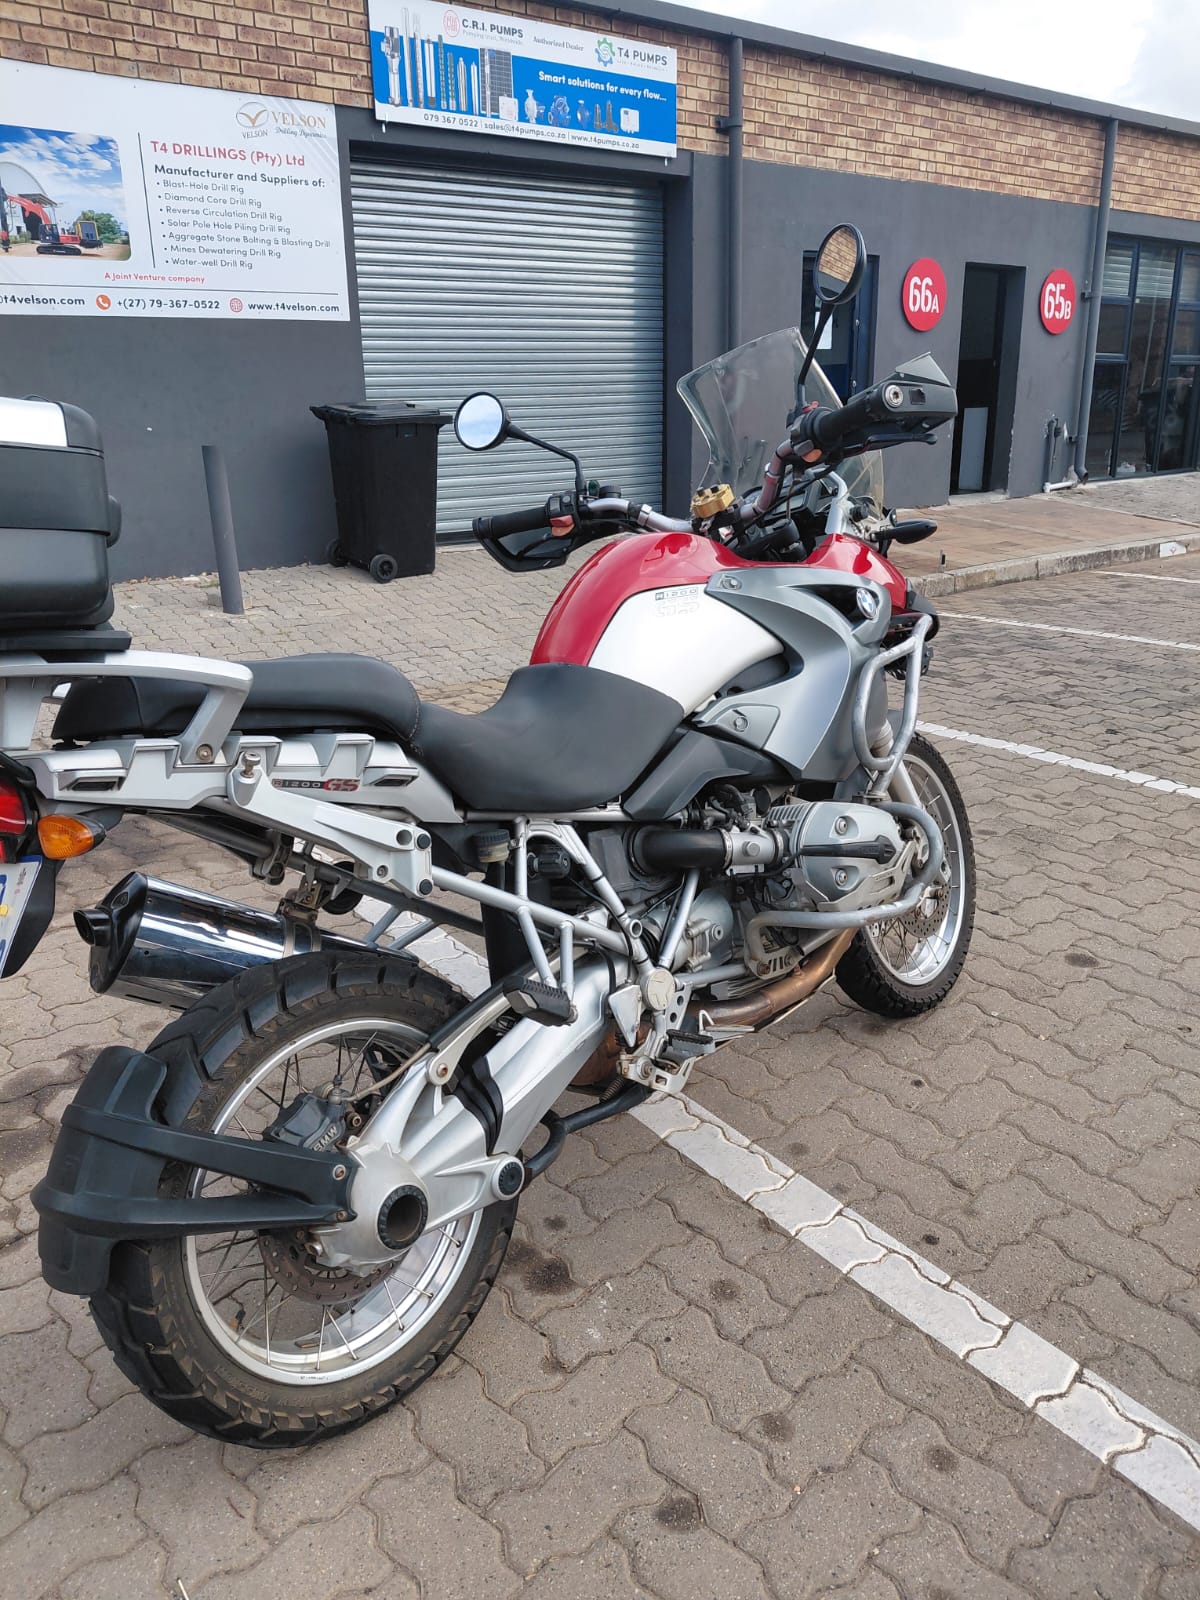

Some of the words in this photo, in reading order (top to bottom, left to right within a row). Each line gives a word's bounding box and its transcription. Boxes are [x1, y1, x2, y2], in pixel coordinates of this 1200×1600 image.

[461, 18, 487, 32] C.R.I.
[489, 23, 524, 39] PUMPS
[565, 41, 584, 52] Dealer
[617, 47, 630, 59] T4
[633, 50, 668, 66] PUMPS
[538, 70, 566, 84] Smart
[567, 77, 605, 92] solutions
[606, 82, 619, 94] for
[619, 87, 642, 99] every
[271, 111, 327, 129] VELSON
[423, 113, 439, 123] 079
[441, 115, 457, 125] 367
[458, 118, 479, 128] 0522
[242, 128, 268, 140] VELSON
[150, 140, 168, 154] T4
[172, 143, 247, 162] DRILLINGS
[250, 150, 282, 168] (Pty)
[285, 153, 305, 167] Ltd
[154, 164, 234, 180] Manufacturer
[236, 172, 258, 182] and
[260, 173, 309, 187] Suppliers
[311, 178, 325, 188] of:
[163, 179, 209, 191] Blast-Hole
[211, 183, 229, 192] Drill
[230, 184, 244, 195] Rig
[164, 192, 205, 203] Diamond
[206, 195, 228, 205] Core
[229, 197, 247, 206] Drill
[248, 198, 262, 209] Rig
[166, 205, 200, 216] Reverse
[202, 207, 249, 218] Circulation
[250, 211, 268, 220] Drill
[269, 212, 283, 223] Rig
[167, 219, 190, 228] Solar
[192, 220, 211, 229] Pole
[213, 221, 233, 230] Hole
[234, 222, 258, 234] Piling
[259, 224, 276, 233] Drill
[277, 225, 291, 236] Rig
[168, 231, 215, 243] Aggregate
[216, 234, 241, 243] Stone
[242, 235, 272, 247] Bolting
[281, 237, 313, 249] Blasting
[314, 239, 331, 248] Drill
[170, 244, 197, 254] Mines
[198, 245, 248, 257] Dewatering
[249, 248, 267, 257] Drill
[268, 249, 281, 260] Rig
[171, 257, 219, 267] Water-well
[220, 259, 238, 268] Drill
[239, 260, 253, 270] Rig
[104, 272, 111, 280] A
[112, 272, 132, 282] Joint
[133, 273, 166, 282] Venture
[168, 275, 205, 285] company
[0, 294, 86, 306] t4velson.com
[908, 276, 940, 314] 66A
[1043, 282, 1072, 320] 65B
[117, 298, 147, 311] +(27)
[149, 299, 221, 310] 79-367-0522
[247, 302, 340, 313] www.t4velson.com
[312, 1126, 337, 1151] BMW
